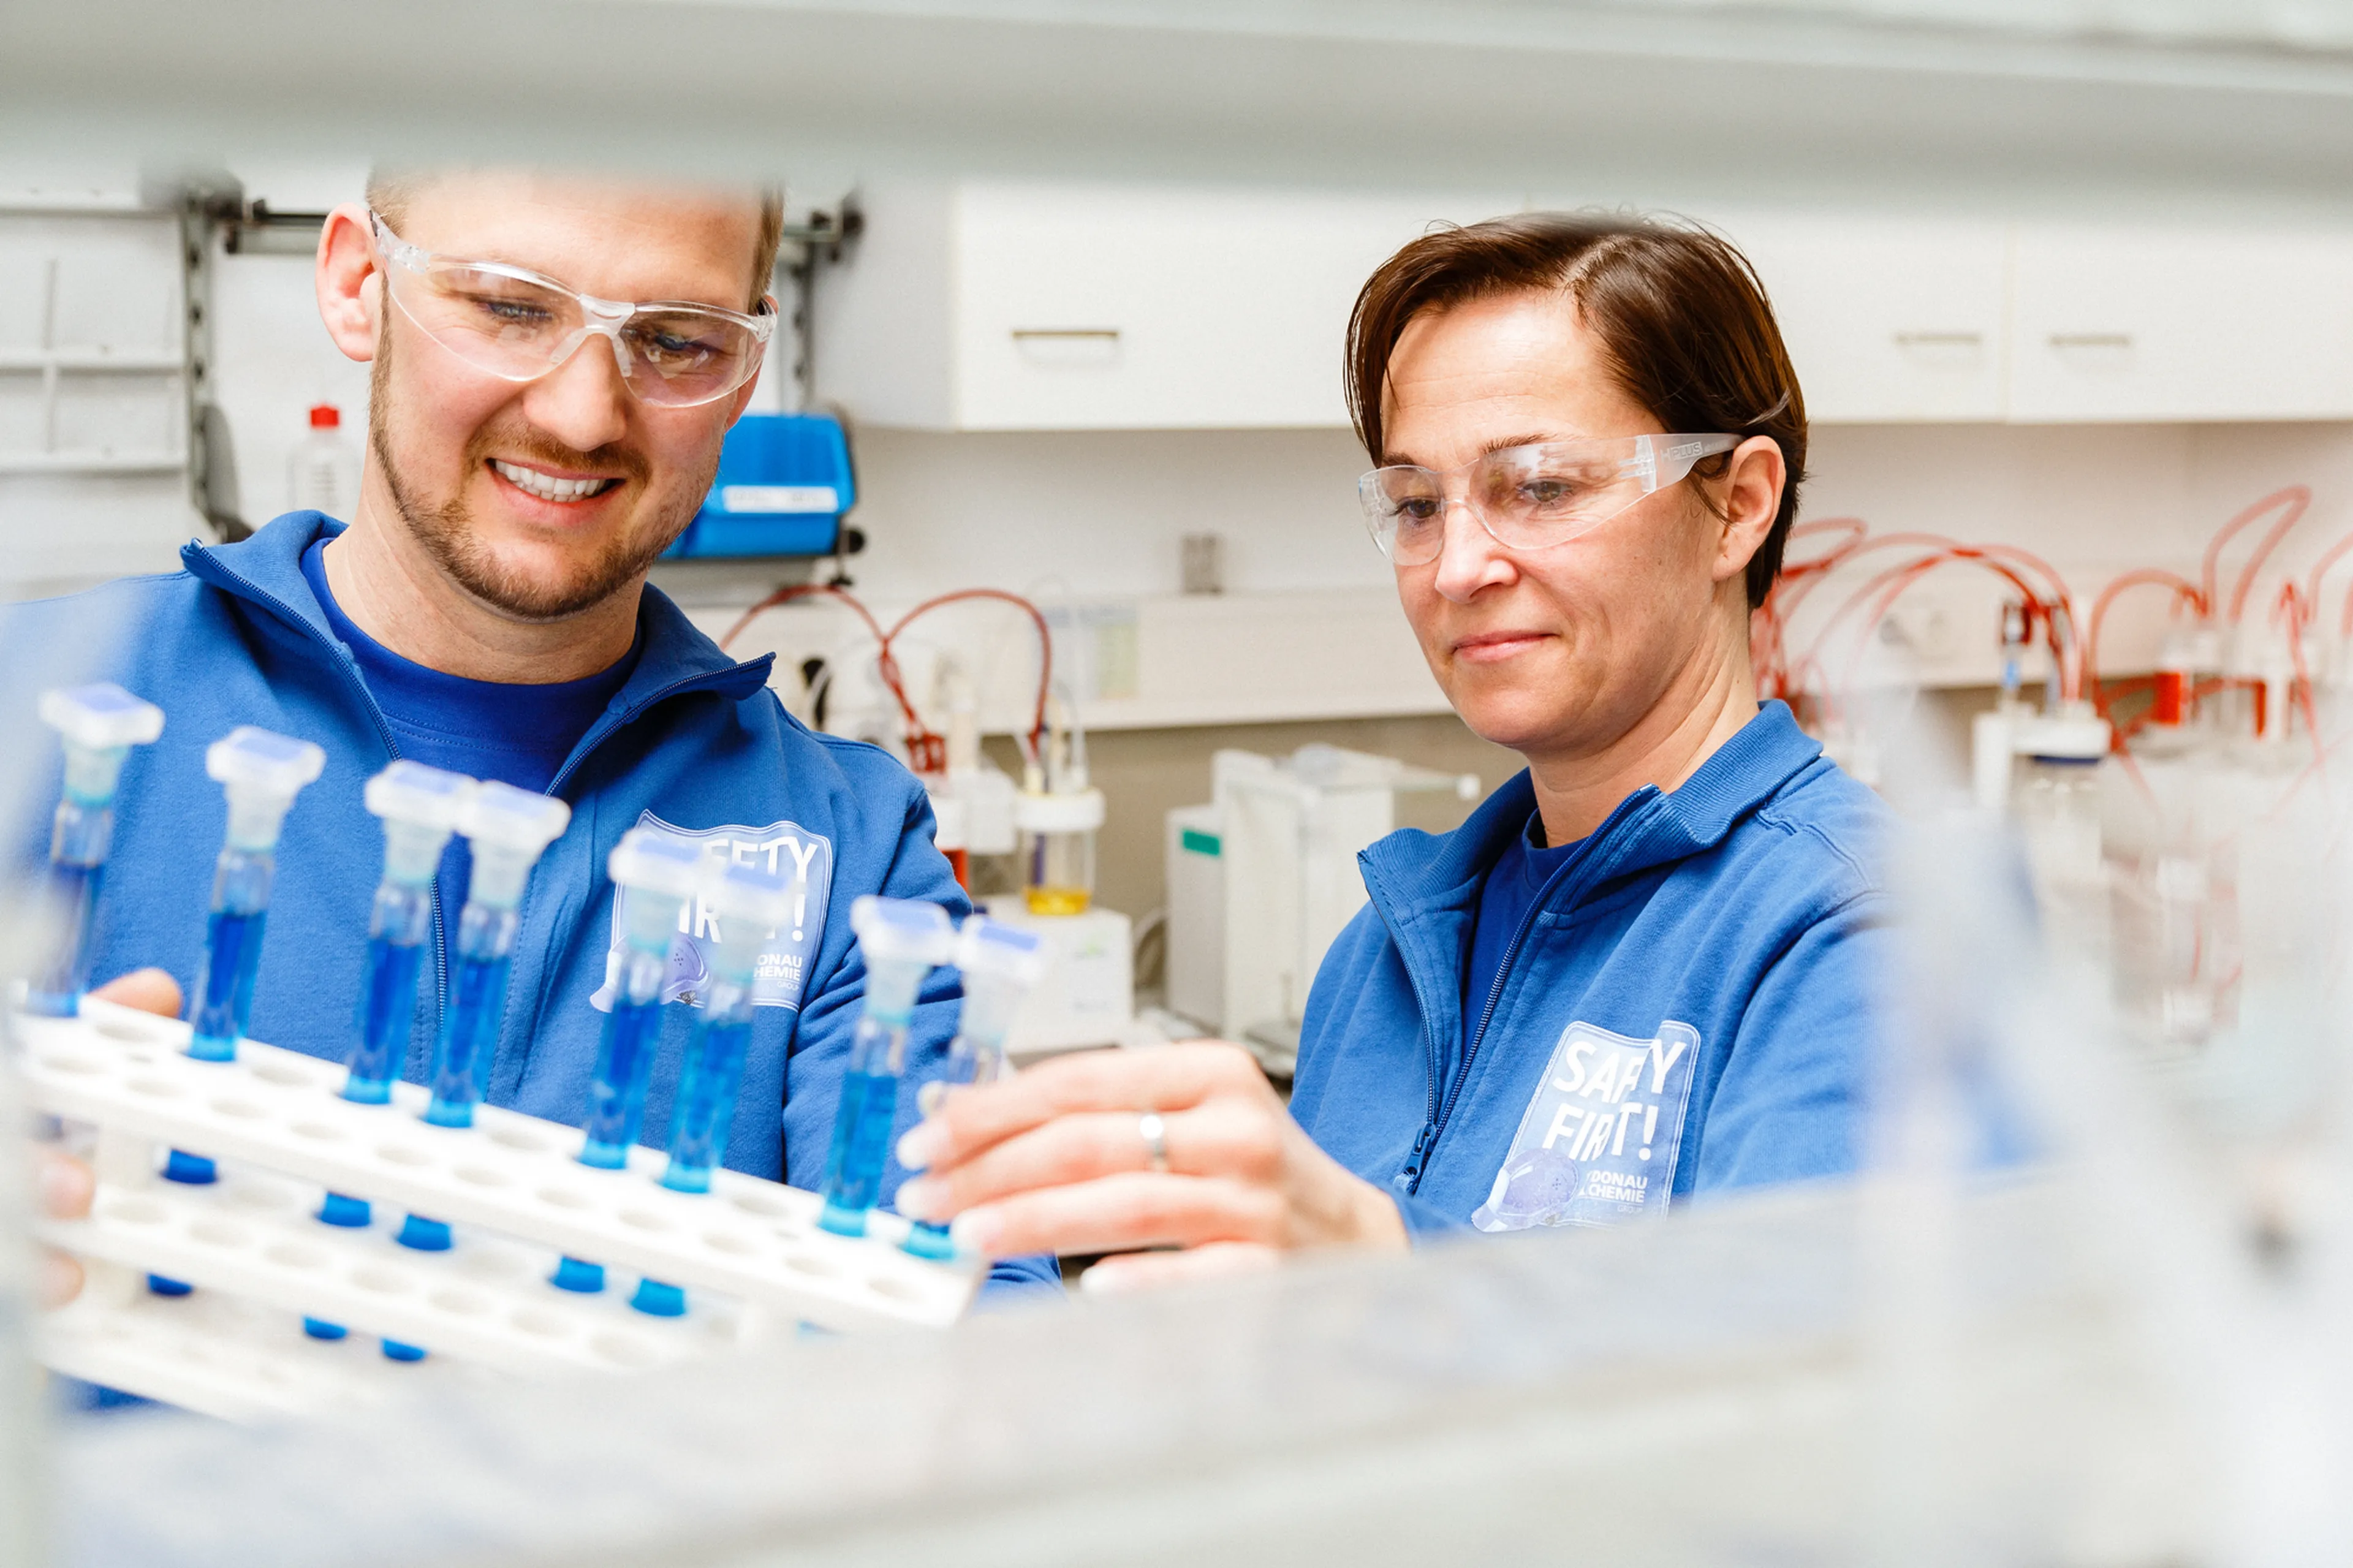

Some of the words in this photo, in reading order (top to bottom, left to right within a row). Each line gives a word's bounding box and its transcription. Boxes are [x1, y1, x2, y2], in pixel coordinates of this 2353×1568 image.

[1672, 442, 1700, 457] PLUS
[643, 831, 818, 883] FETY
[757, 953, 802, 968] ONAU
[753, 966, 800, 981] HEMIE
[1542, 1102, 1659, 1162] FIRT!
[1590, 1170, 1648, 1190] DONAU
[1588, 1183, 1646, 1203] CHEMIE
